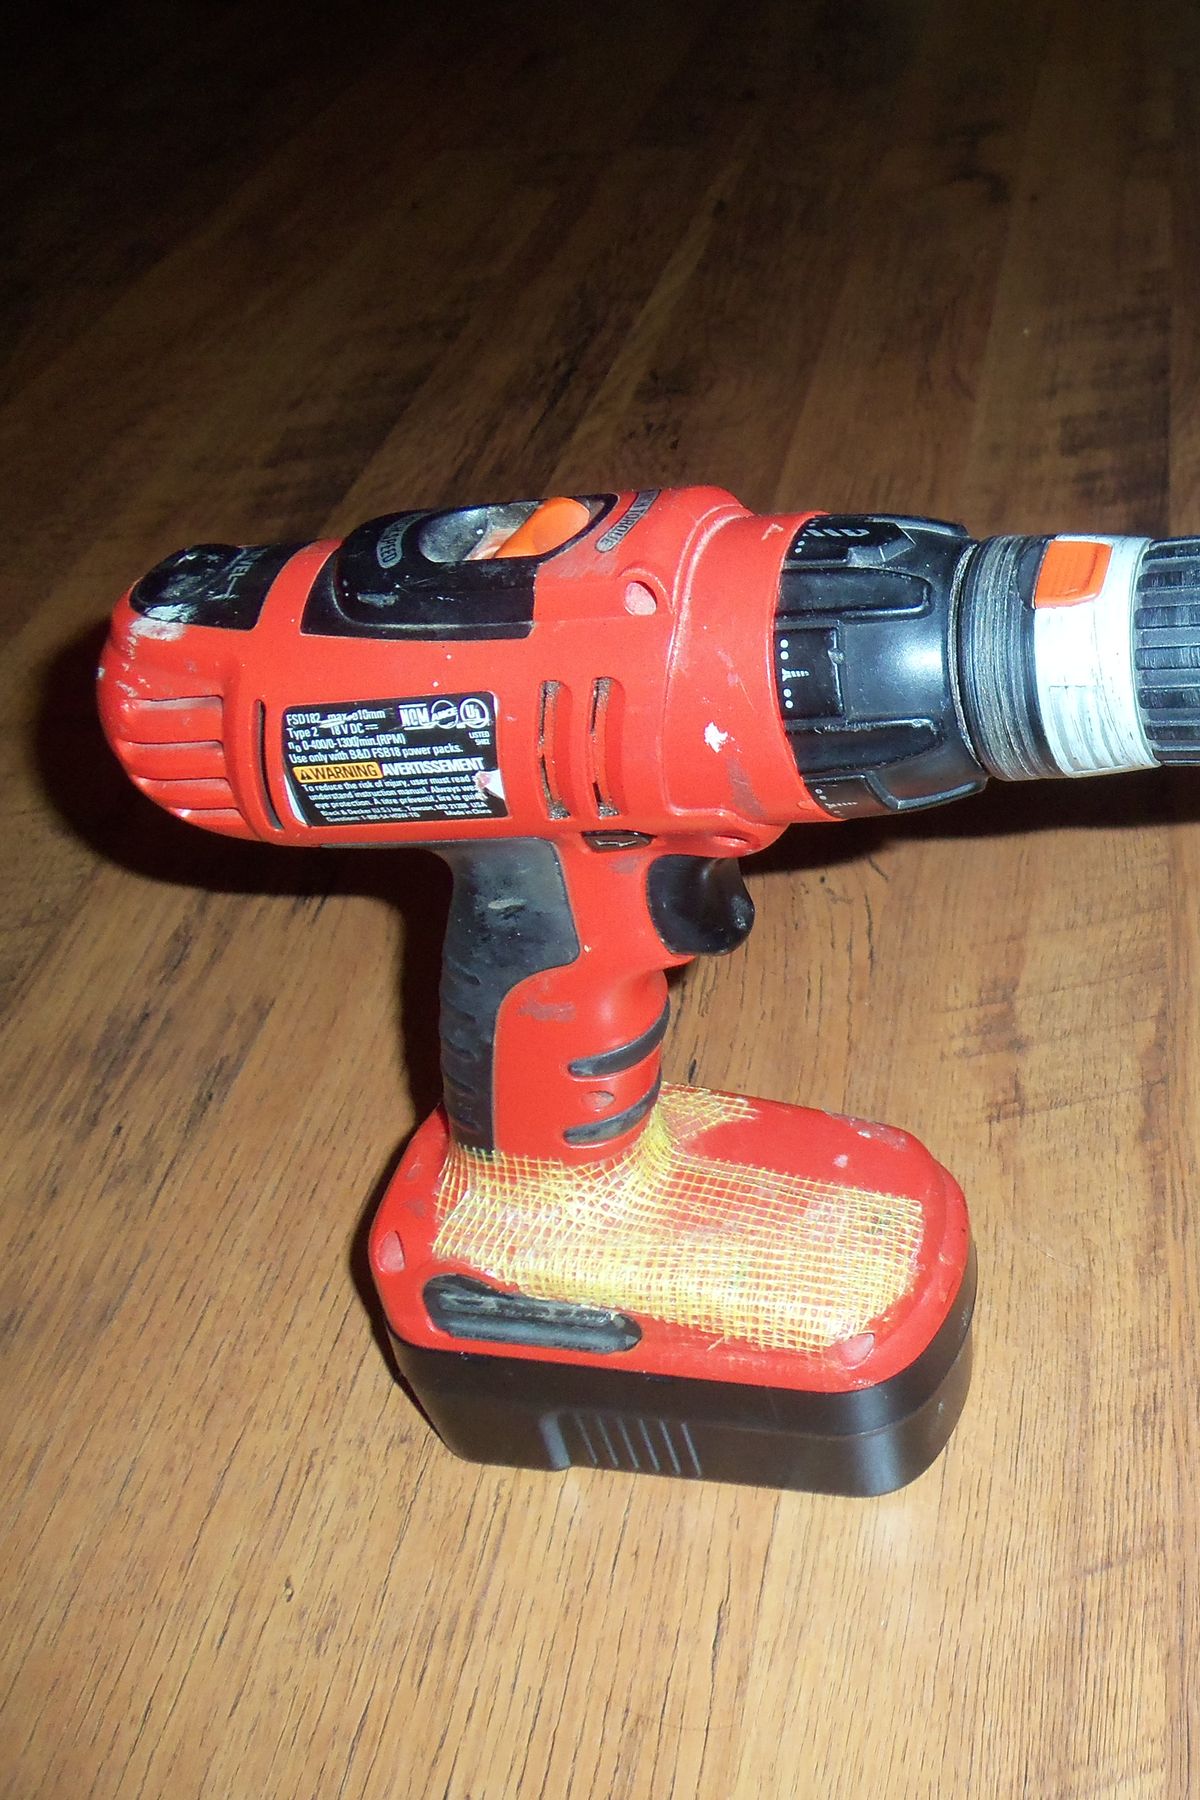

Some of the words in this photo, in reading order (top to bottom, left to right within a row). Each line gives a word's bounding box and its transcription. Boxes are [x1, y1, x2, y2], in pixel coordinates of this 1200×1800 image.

[286, 712, 320, 726] FSD182
[286, 727, 311, 740] Type
[311, 726, 319, 737] 2
[330, 724, 341, 736] 18
[350, 722, 365, 734] DC
[468, 730, 490, 739] LISTED
[289, 753, 308, 764] Use
[309, 752, 328, 764] only
[328, 749, 349, 762] with
[349, 748, 371, 760] B&D
[372, 746, 402, 759] FSB18
[402, 746, 431, 758] power
[432, 743, 464, 756] packs.
[310, 765, 378, 779] WARNING
[381, 757, 485, 776] AVERTISSEMENT
[301, 784, 314, 792] To
[315, 782, 344, 792] reduce
[344, 781, 358, 790] the
[358, 780, 374, 789] risk
[375, 779, 384, 788] of
[409, 778, 428, 787] user
[429, 776, 451, 785] must
[450, 774, 471, 784] read
[308, 791, 354, 801] understand
[354, 788, 397, 799] instruction
[430, 785, 461, 795] Always
